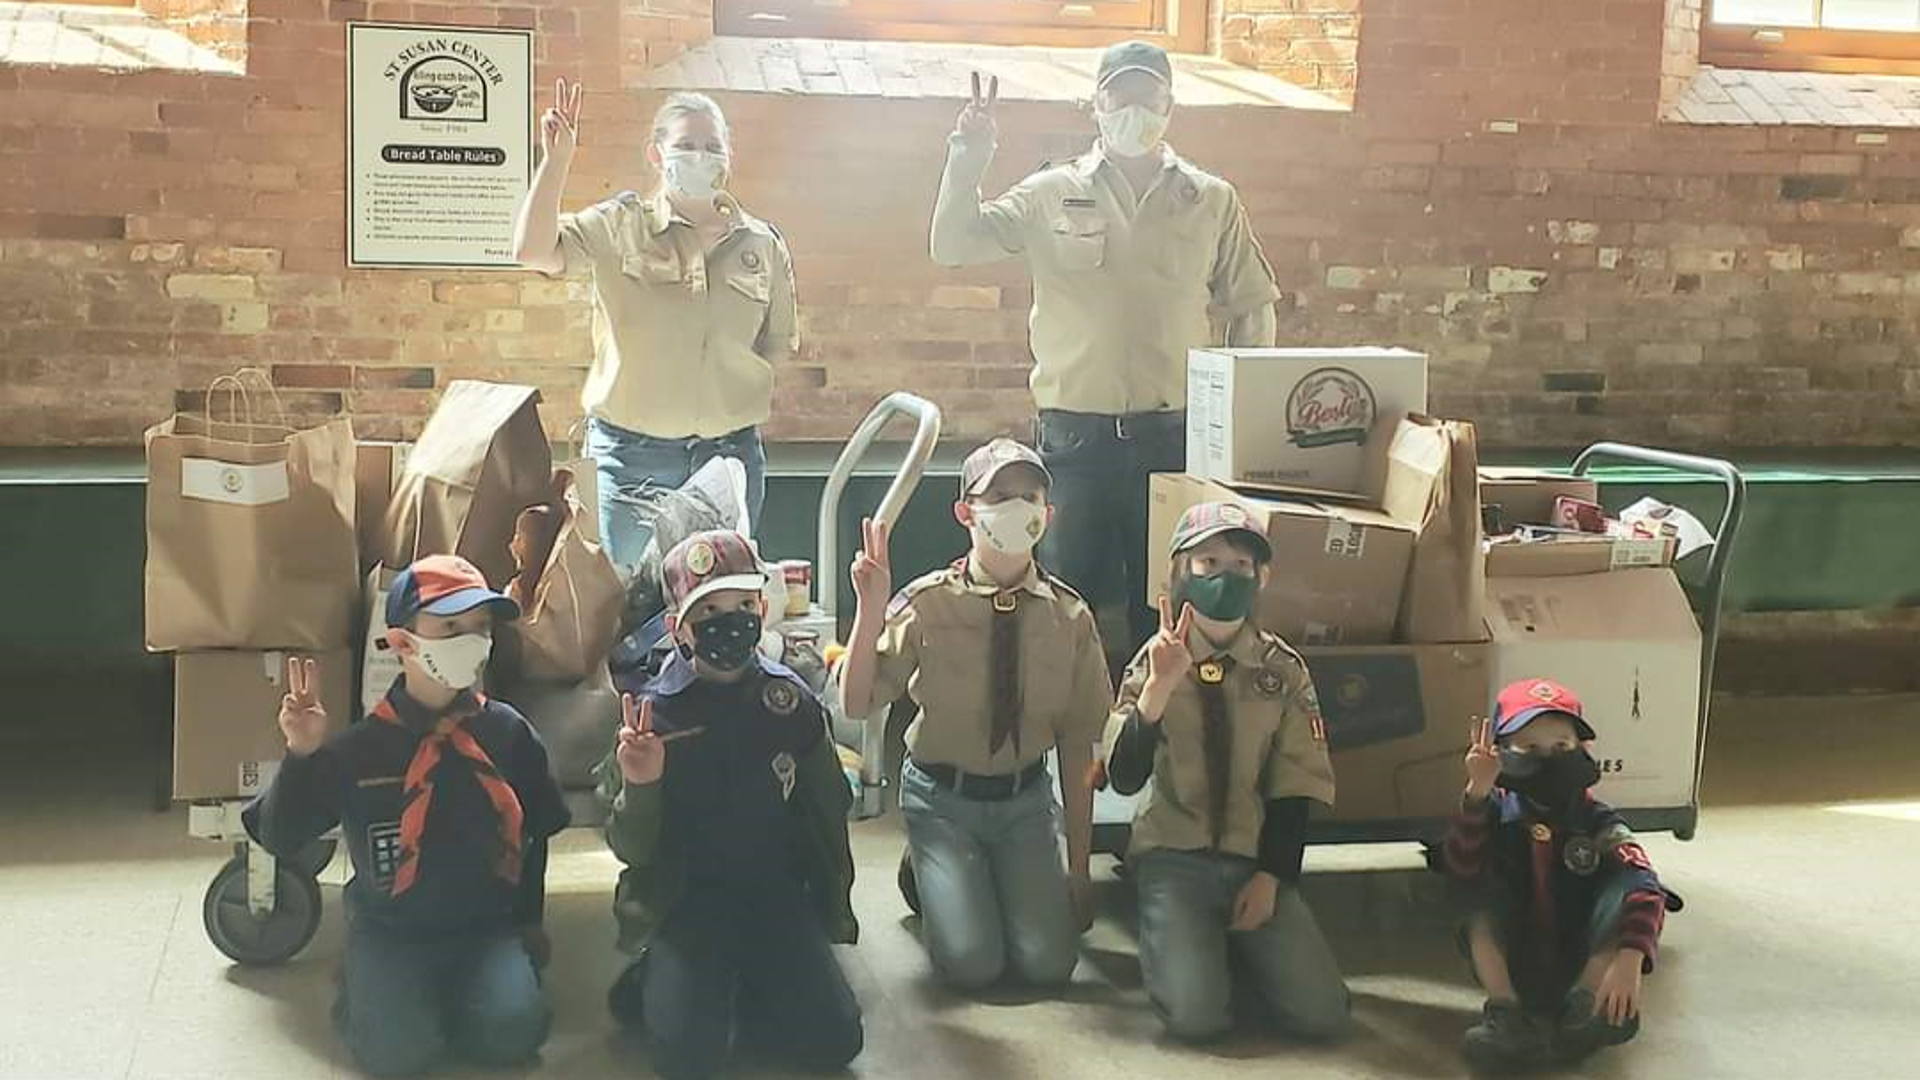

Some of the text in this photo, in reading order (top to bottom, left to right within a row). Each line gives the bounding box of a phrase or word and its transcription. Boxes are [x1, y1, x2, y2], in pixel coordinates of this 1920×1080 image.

[383, 39, 503, 86] ST SUSAN CENTER
[390, 148, 497, 163] Bread Table Rules
